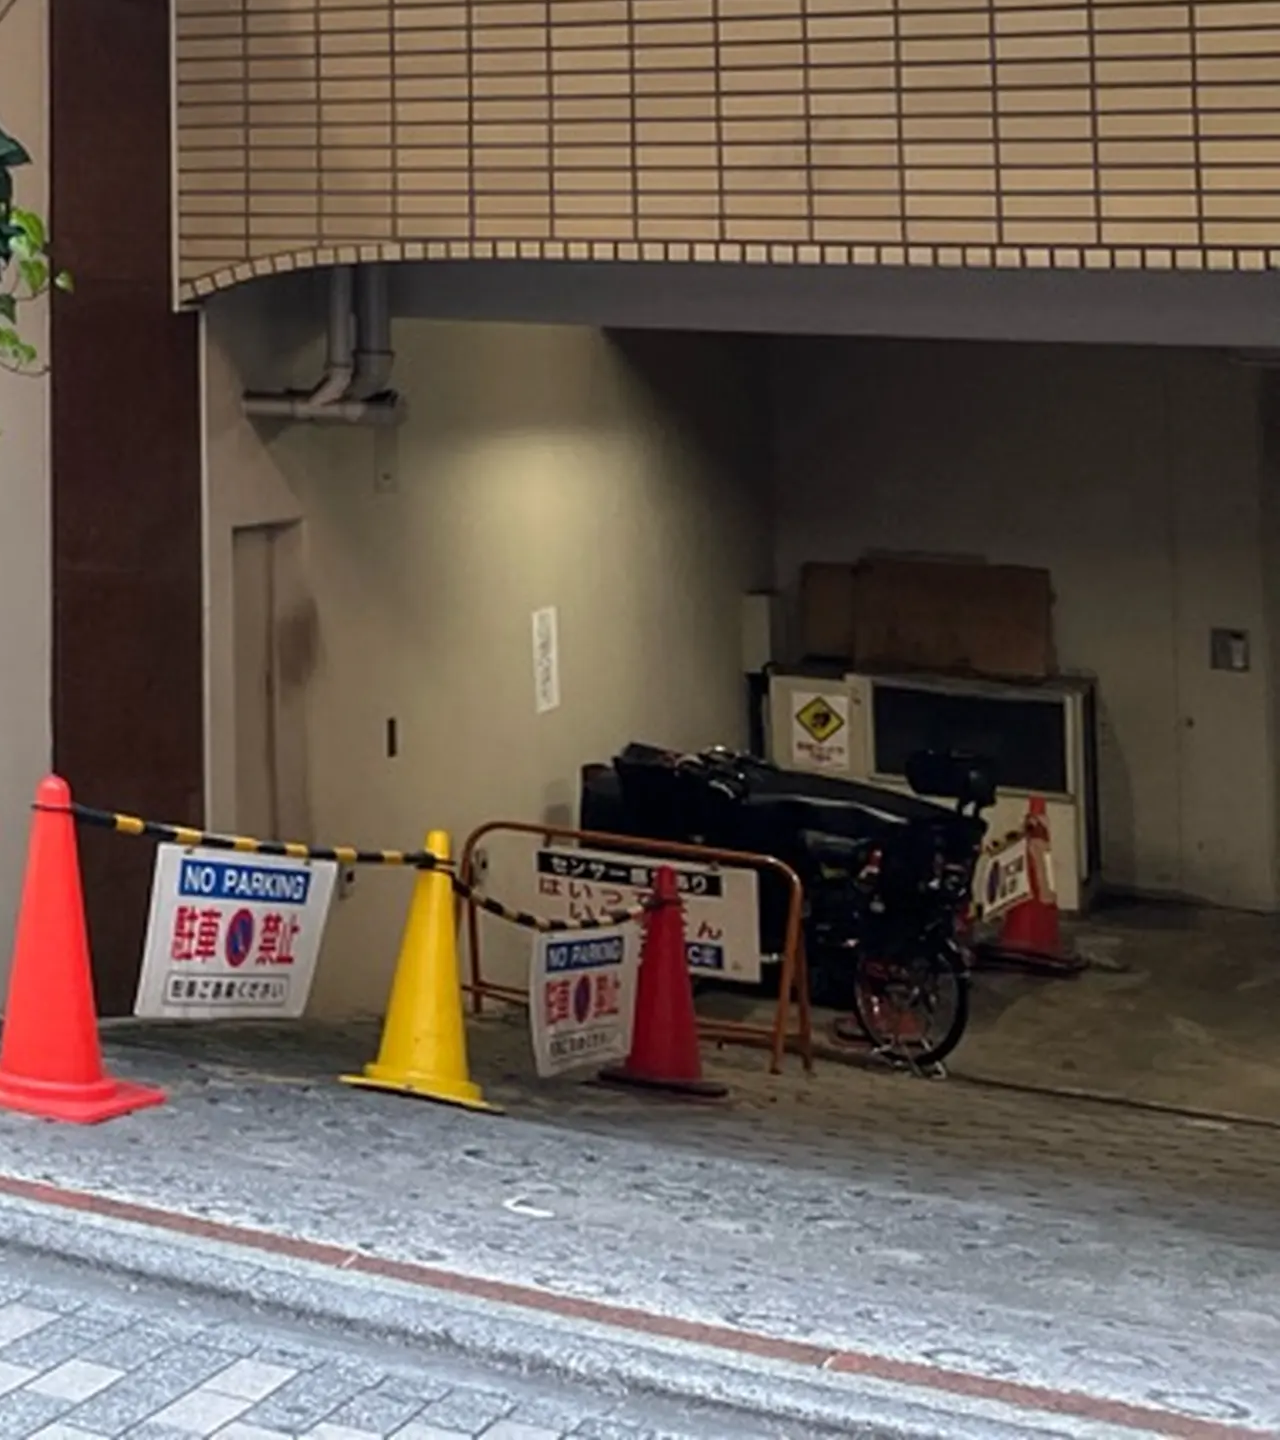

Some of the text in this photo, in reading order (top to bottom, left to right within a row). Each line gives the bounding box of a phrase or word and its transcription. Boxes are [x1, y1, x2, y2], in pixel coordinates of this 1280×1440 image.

[184, 865, 305, 901] NO PARKING
[550, 857, 707, 893] センサー感あり
[171, 906, 300, 966] 駐車 禁止
[549, 940, 621, 968] NO PARKING
